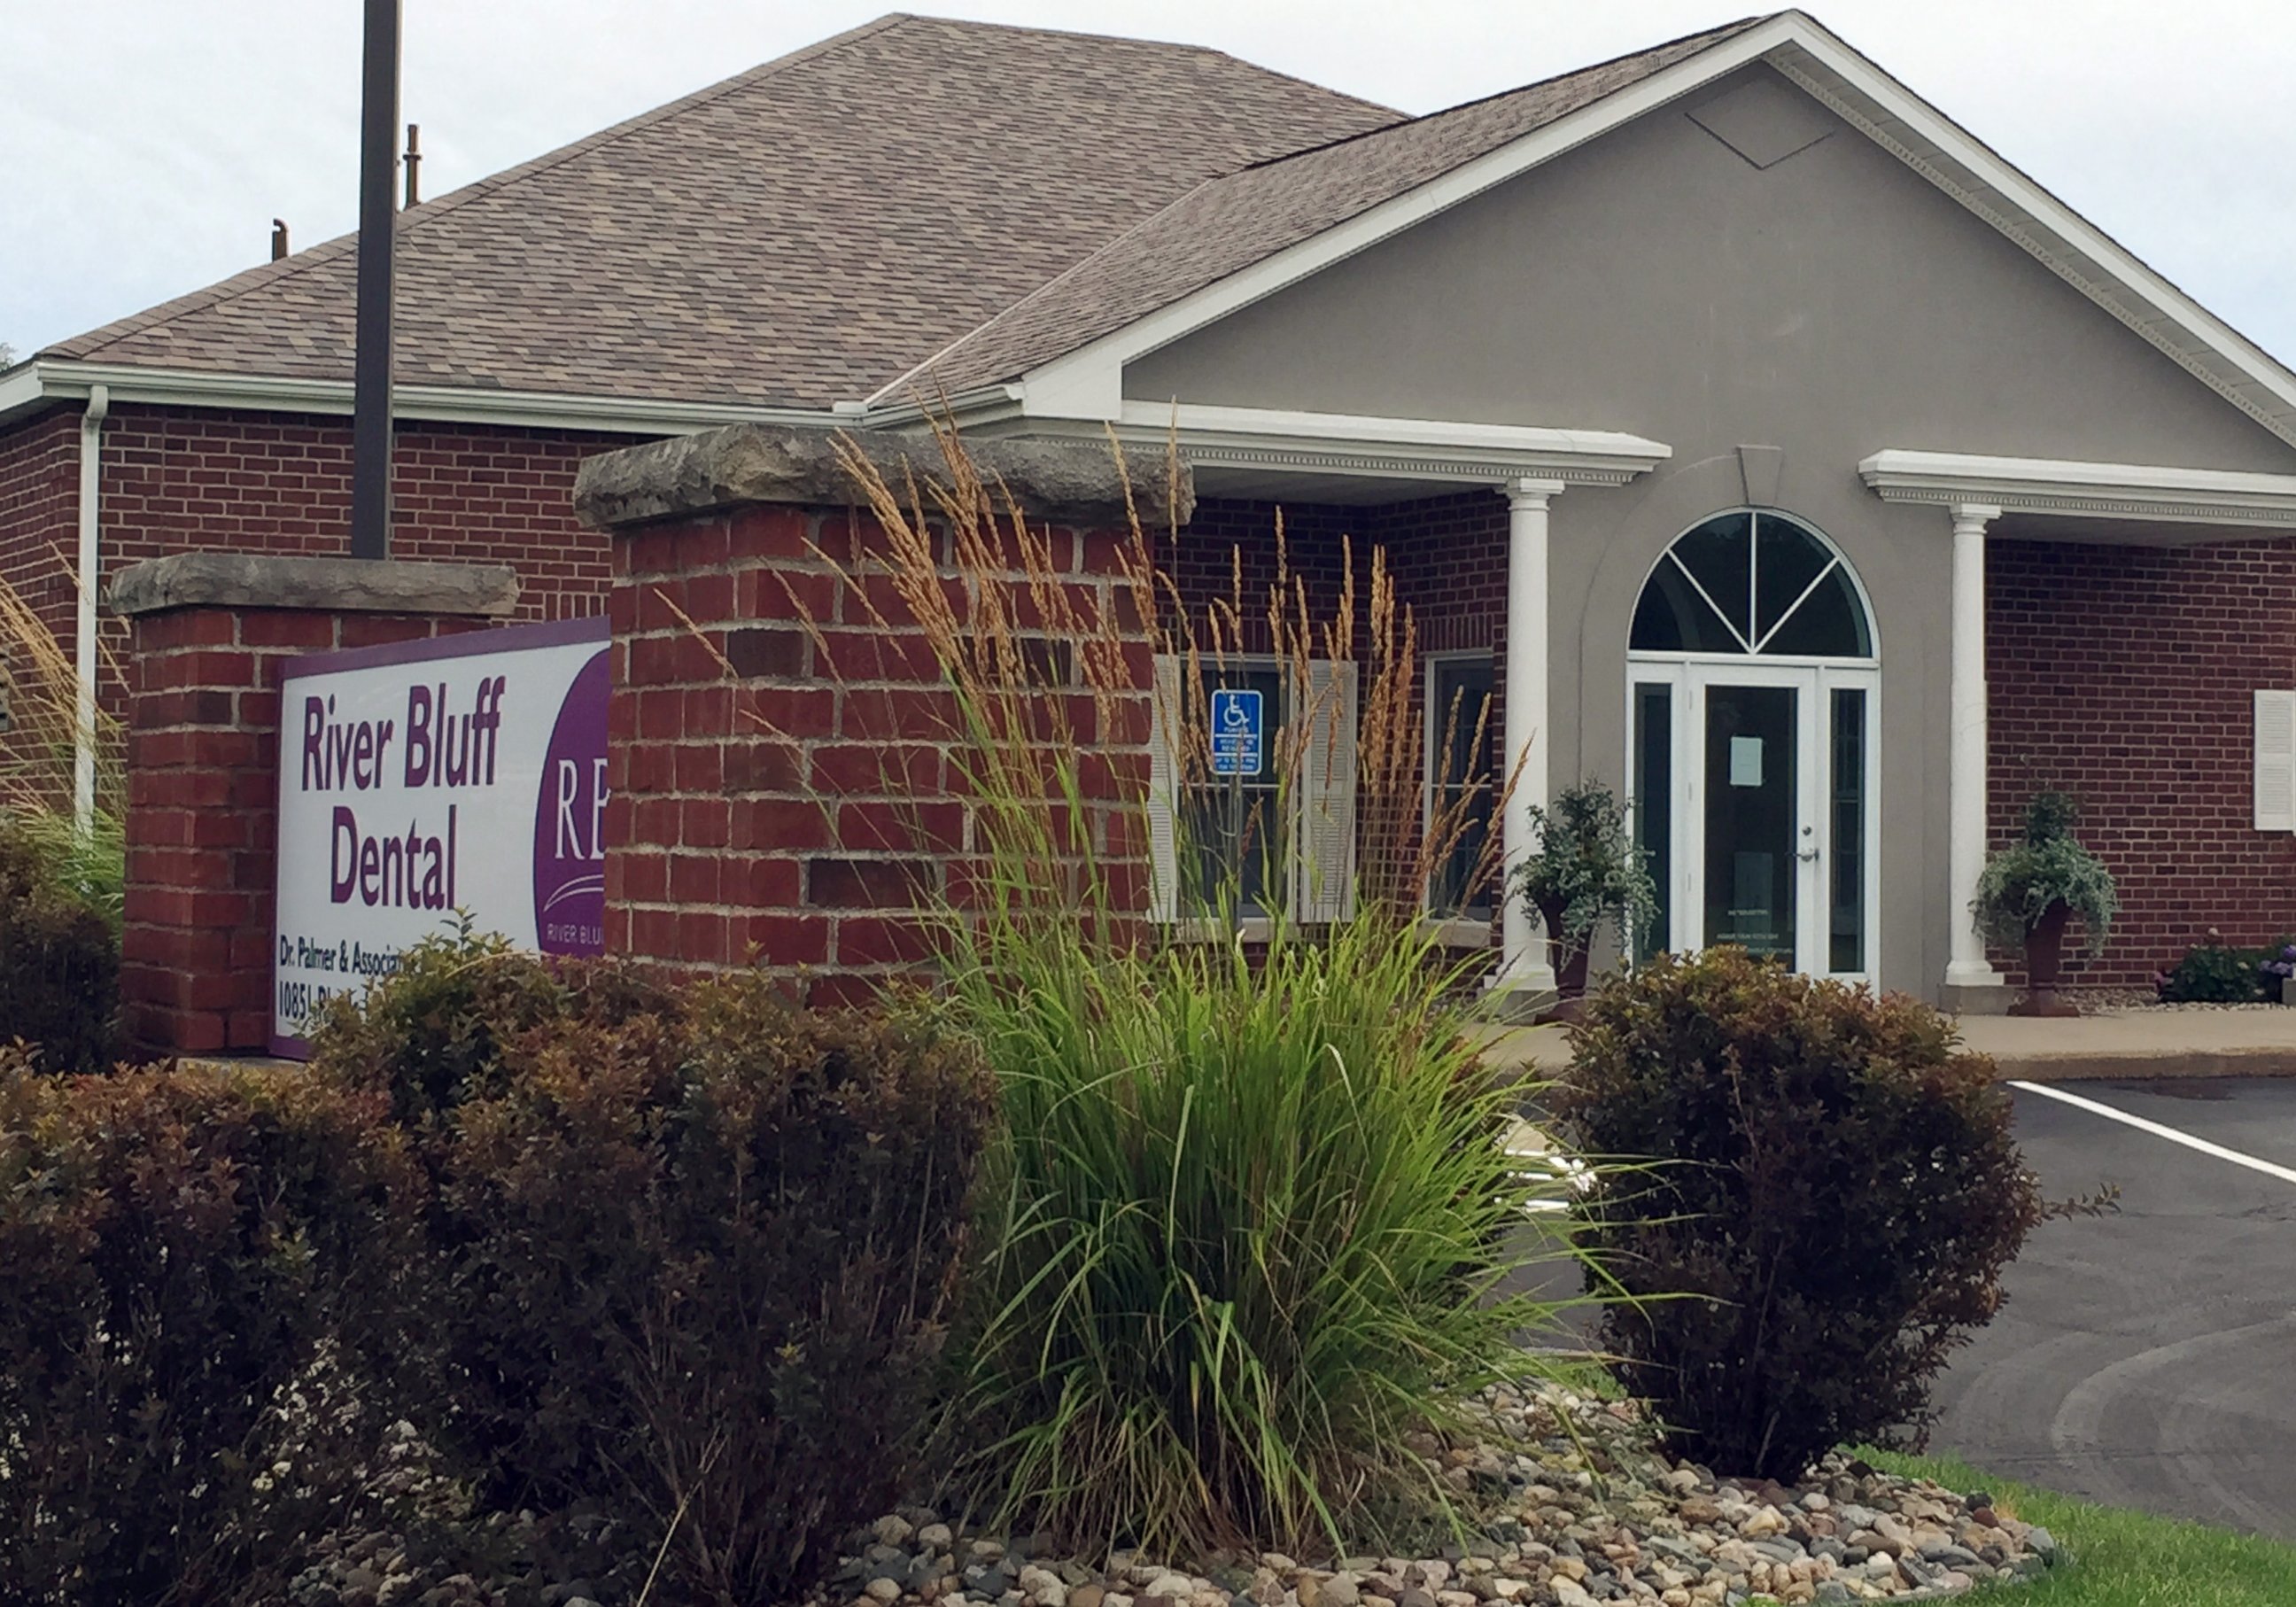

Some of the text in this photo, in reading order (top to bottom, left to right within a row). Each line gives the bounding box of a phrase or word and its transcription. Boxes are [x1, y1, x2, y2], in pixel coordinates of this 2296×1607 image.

[302, 675, 506, 791] River Bluff
[331, 804, 457, 911] Dental
[280, 935, 401, 975] Dr. Palmer & Associa
[547, 923, 604, 946] RIVER BLU
